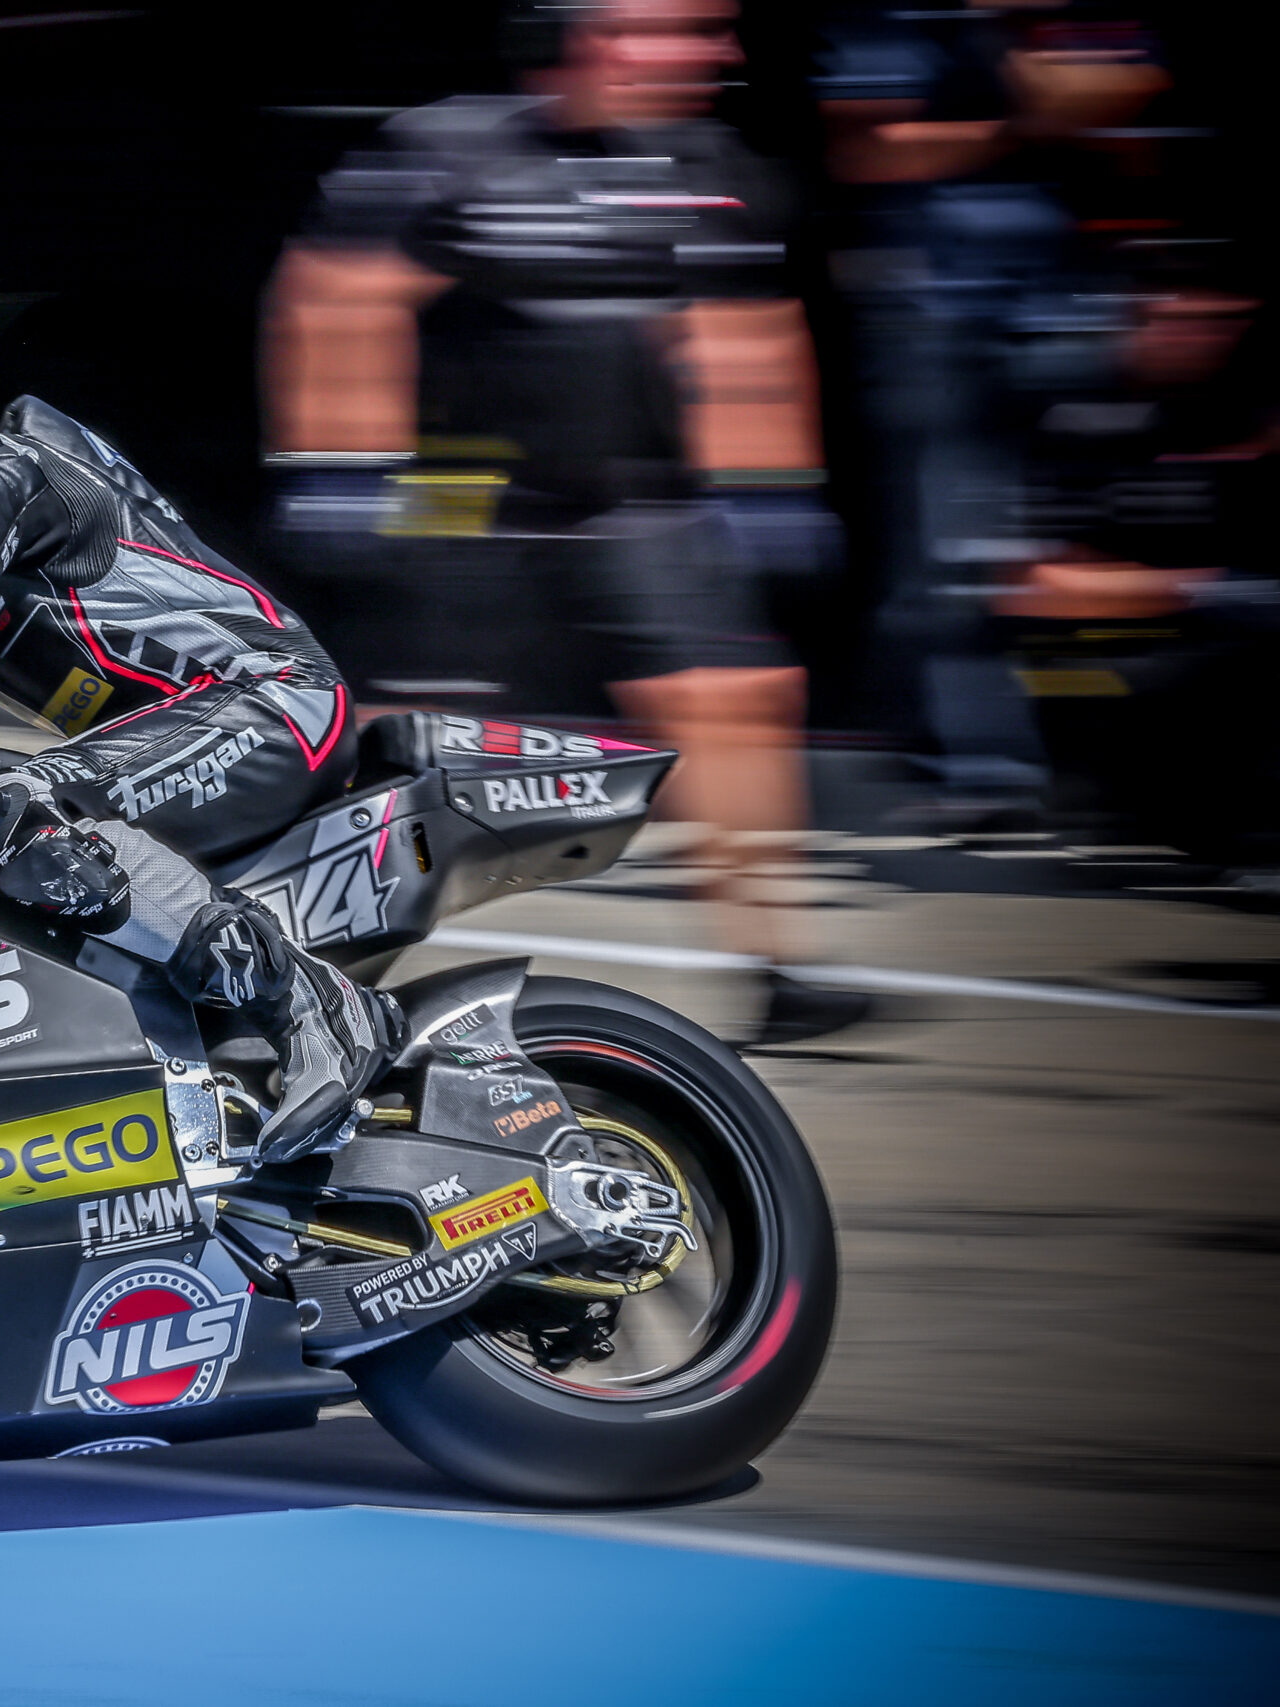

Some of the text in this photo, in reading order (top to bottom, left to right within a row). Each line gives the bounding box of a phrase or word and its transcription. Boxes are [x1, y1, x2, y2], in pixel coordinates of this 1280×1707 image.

[441, 714, 605, 758] REDS
[483, 771, 613, 813] PALLEX
[571, 803, 618, 820] ITALIA
[510, 1100, 562, 1131] Beta
[419, 1173, 470, 1208] RK
[77, 1184, 193, 1248] FIAMM
[440, 1187, 536, 1241] PIRELLI
[352, 1261, 413, 1299] POWERED
[414, 1253, 429, 1271] BY
[359, 1242, 511, 1324] TRIUMPH
[59, 1304, 237, 1393] NILS
